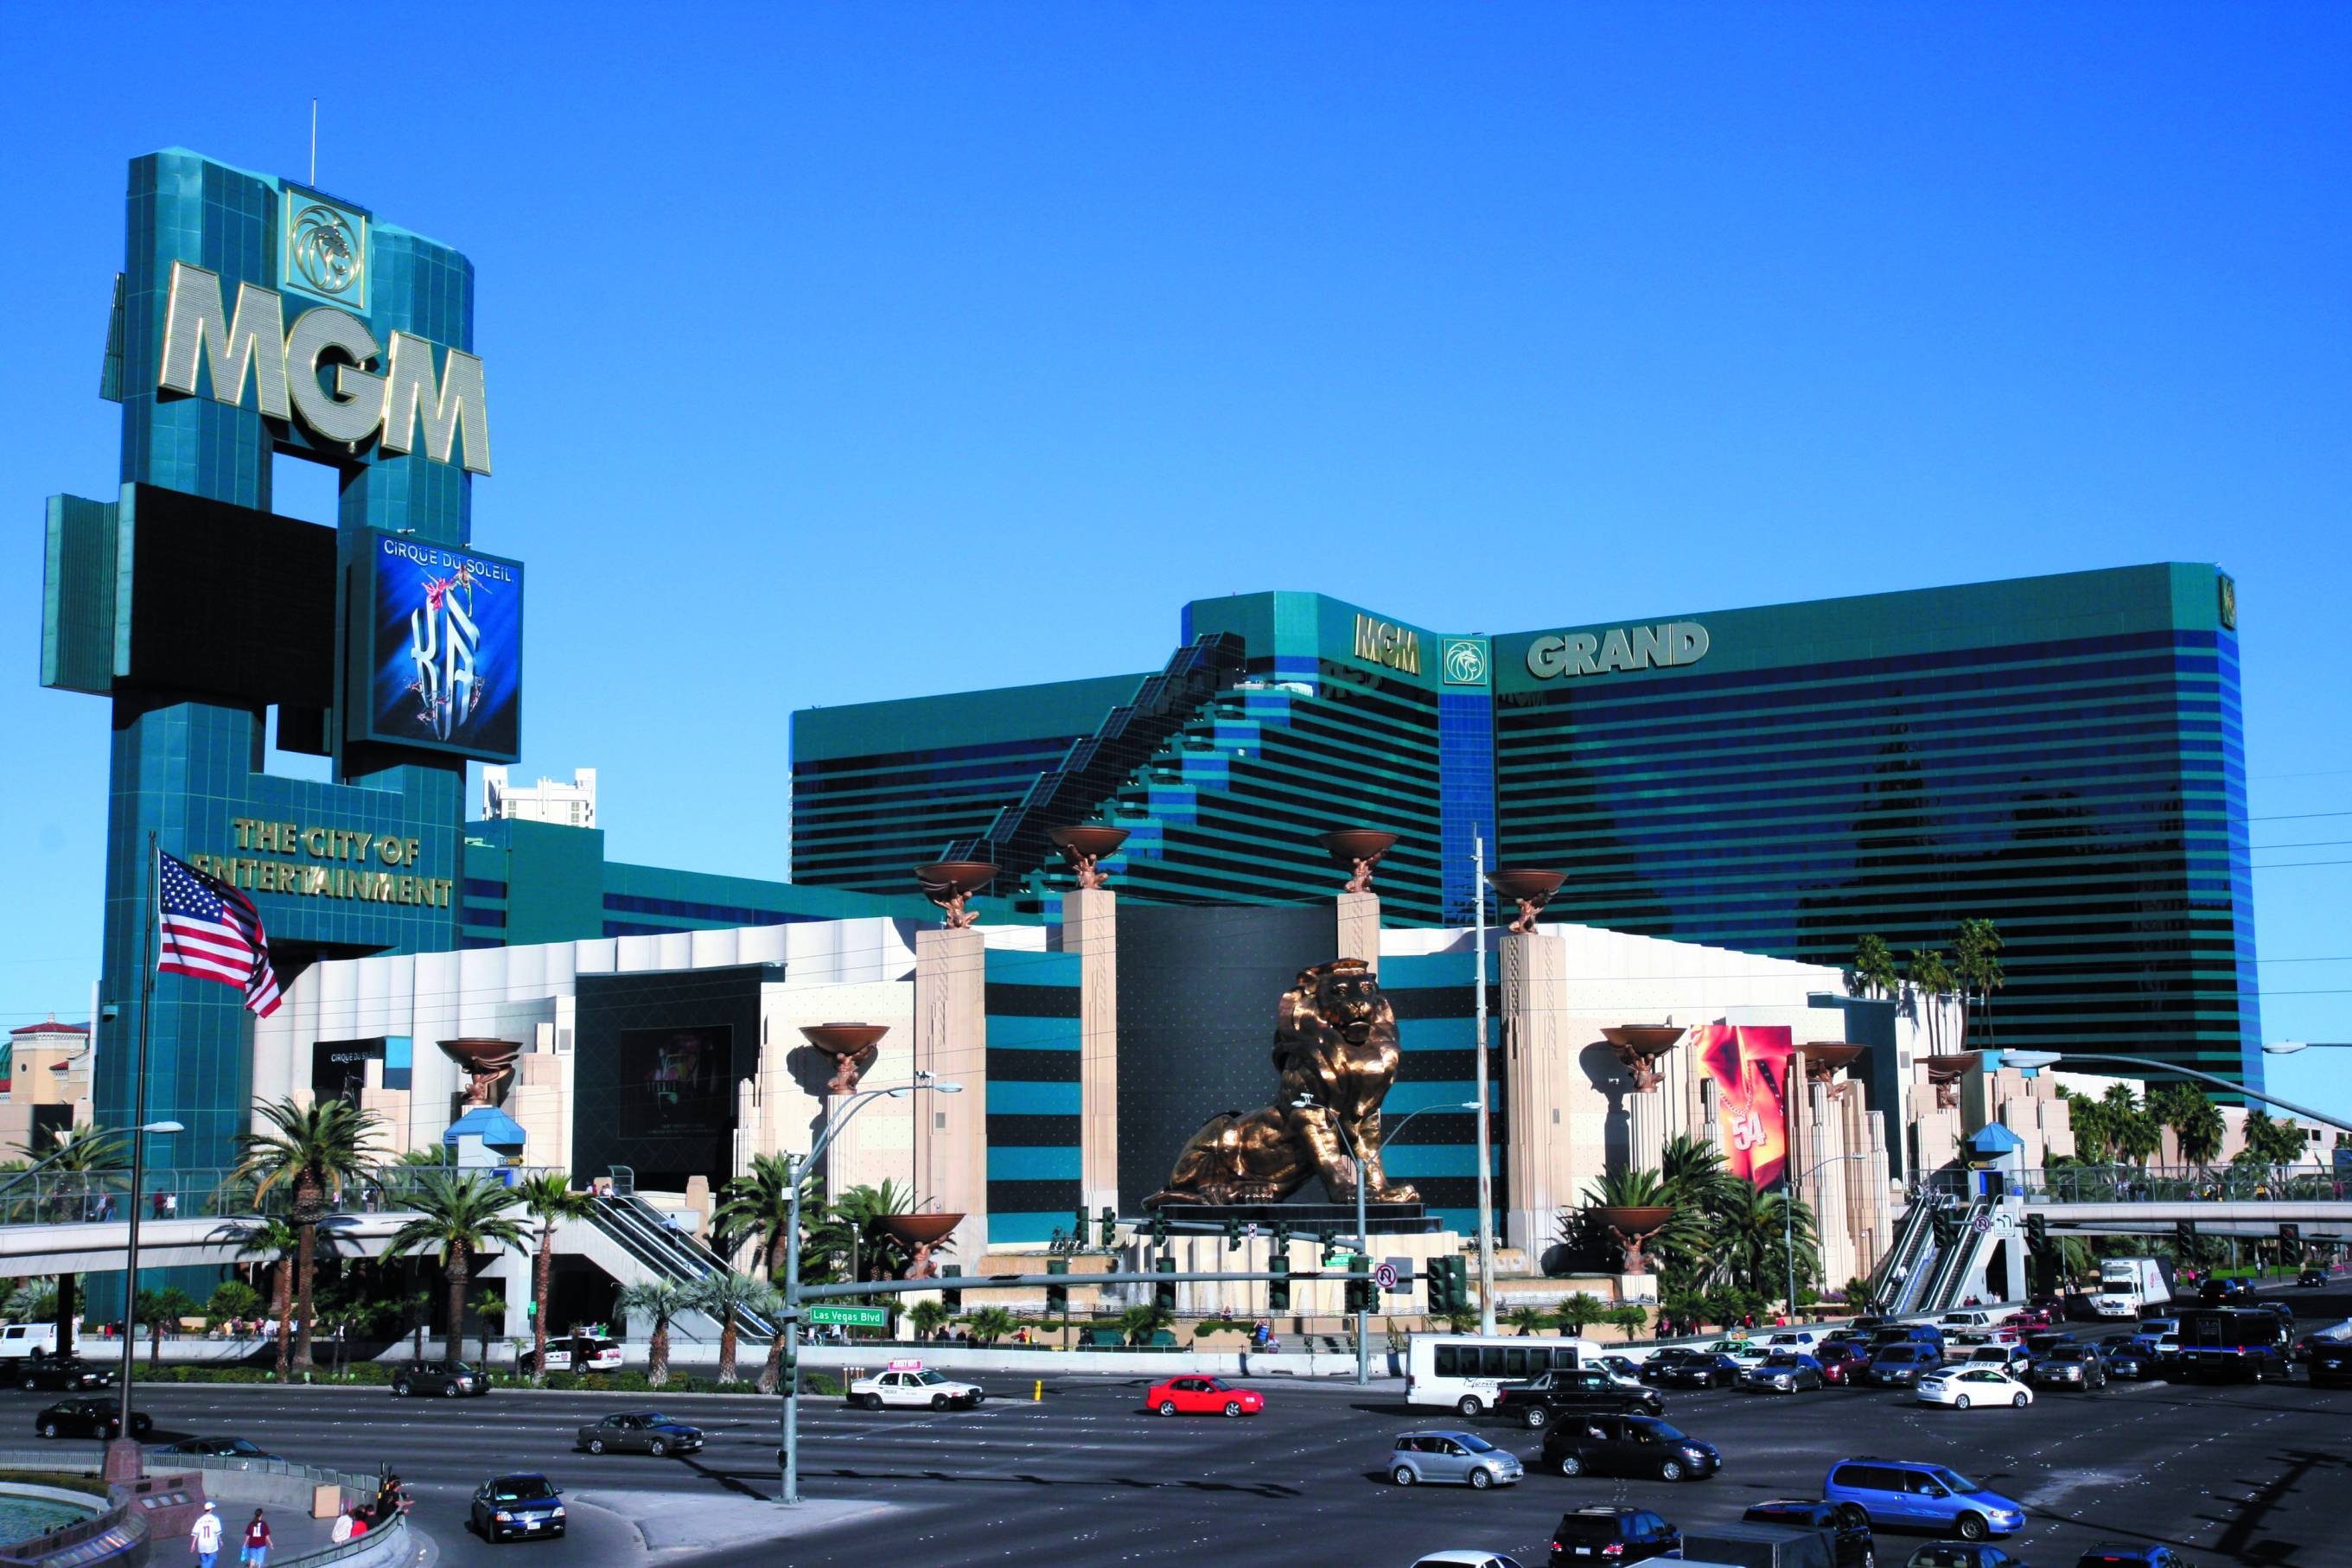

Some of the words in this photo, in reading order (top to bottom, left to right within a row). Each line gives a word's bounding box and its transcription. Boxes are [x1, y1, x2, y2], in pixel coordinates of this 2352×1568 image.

[158, 259, 492, 476] MGM
[384, 539, 438, 566] CIRQUE
[443, 553, 462, 570] DU
[466, 559, 512, 582] SOLEIL
[1354, 614, 1422, 676] MGM
[1527, 621, 1710, 679] GRAND
[234, 818, 296, 852] THE
[304, 826, 373, 862] CITY
[379, 835, 419, 866] OF
[192, 854, 452, 908] ENTERTAINMENT
[1732, 1112, 1767, 1151] 54
[813, 1310, 830, 1320] Las
[832, 1310, 857, 1323] Vegas
[860, 1312, 880, 1322] Blvd
